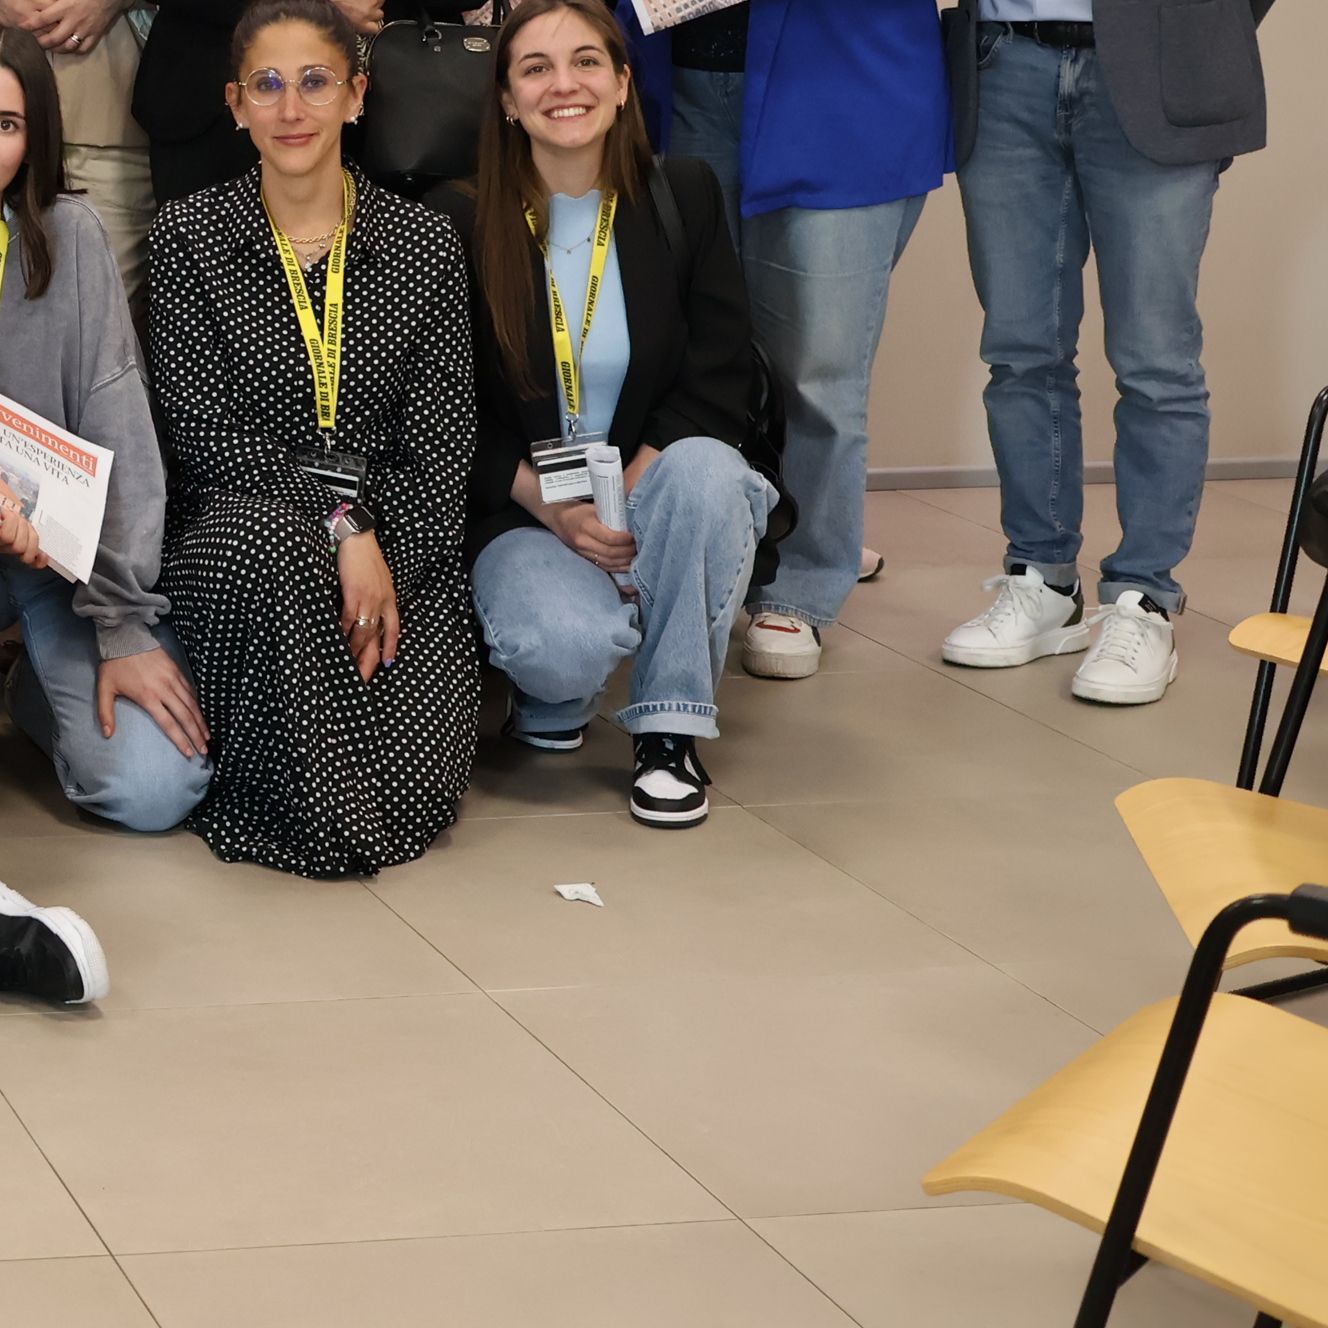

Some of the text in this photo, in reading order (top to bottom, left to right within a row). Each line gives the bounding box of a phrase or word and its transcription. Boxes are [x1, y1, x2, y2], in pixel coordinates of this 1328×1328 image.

[289, 268, 307, 311] BRESCIA
[327, 303, 339, 347] BRESCIA
[309, 337, 328, 390] GIORNALE
[560, 361, 576, 412] GIORNALE
[3, 428, 91, 488] UN'ESPERIENZA
[14, 444, 41, 464] UNA
[42, 460, 70, 486] VITA
